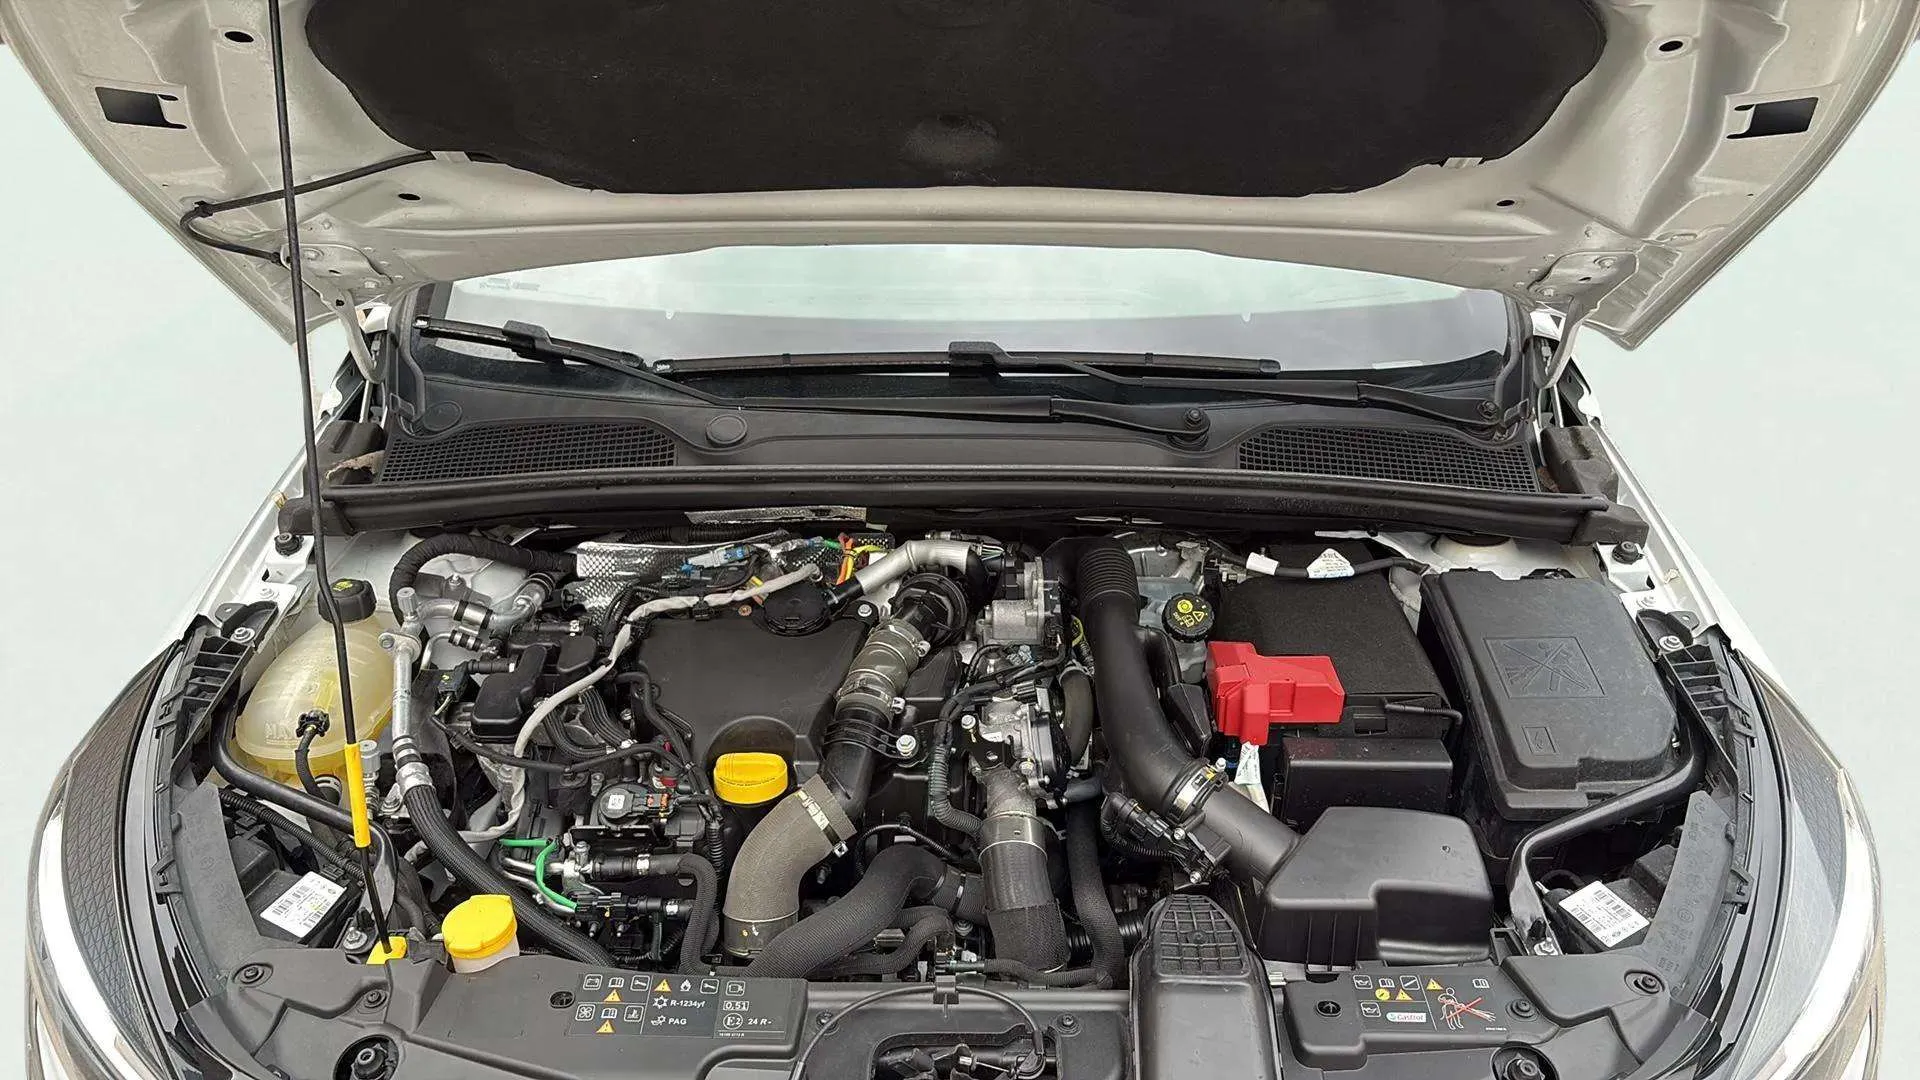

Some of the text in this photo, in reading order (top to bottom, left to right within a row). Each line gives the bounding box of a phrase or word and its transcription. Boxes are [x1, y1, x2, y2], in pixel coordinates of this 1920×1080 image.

[670, 999, 706, 1009] R-1234yf
[668, 1017, 687, 1025] PAG
[726, 1016, 742, 1026] E2
